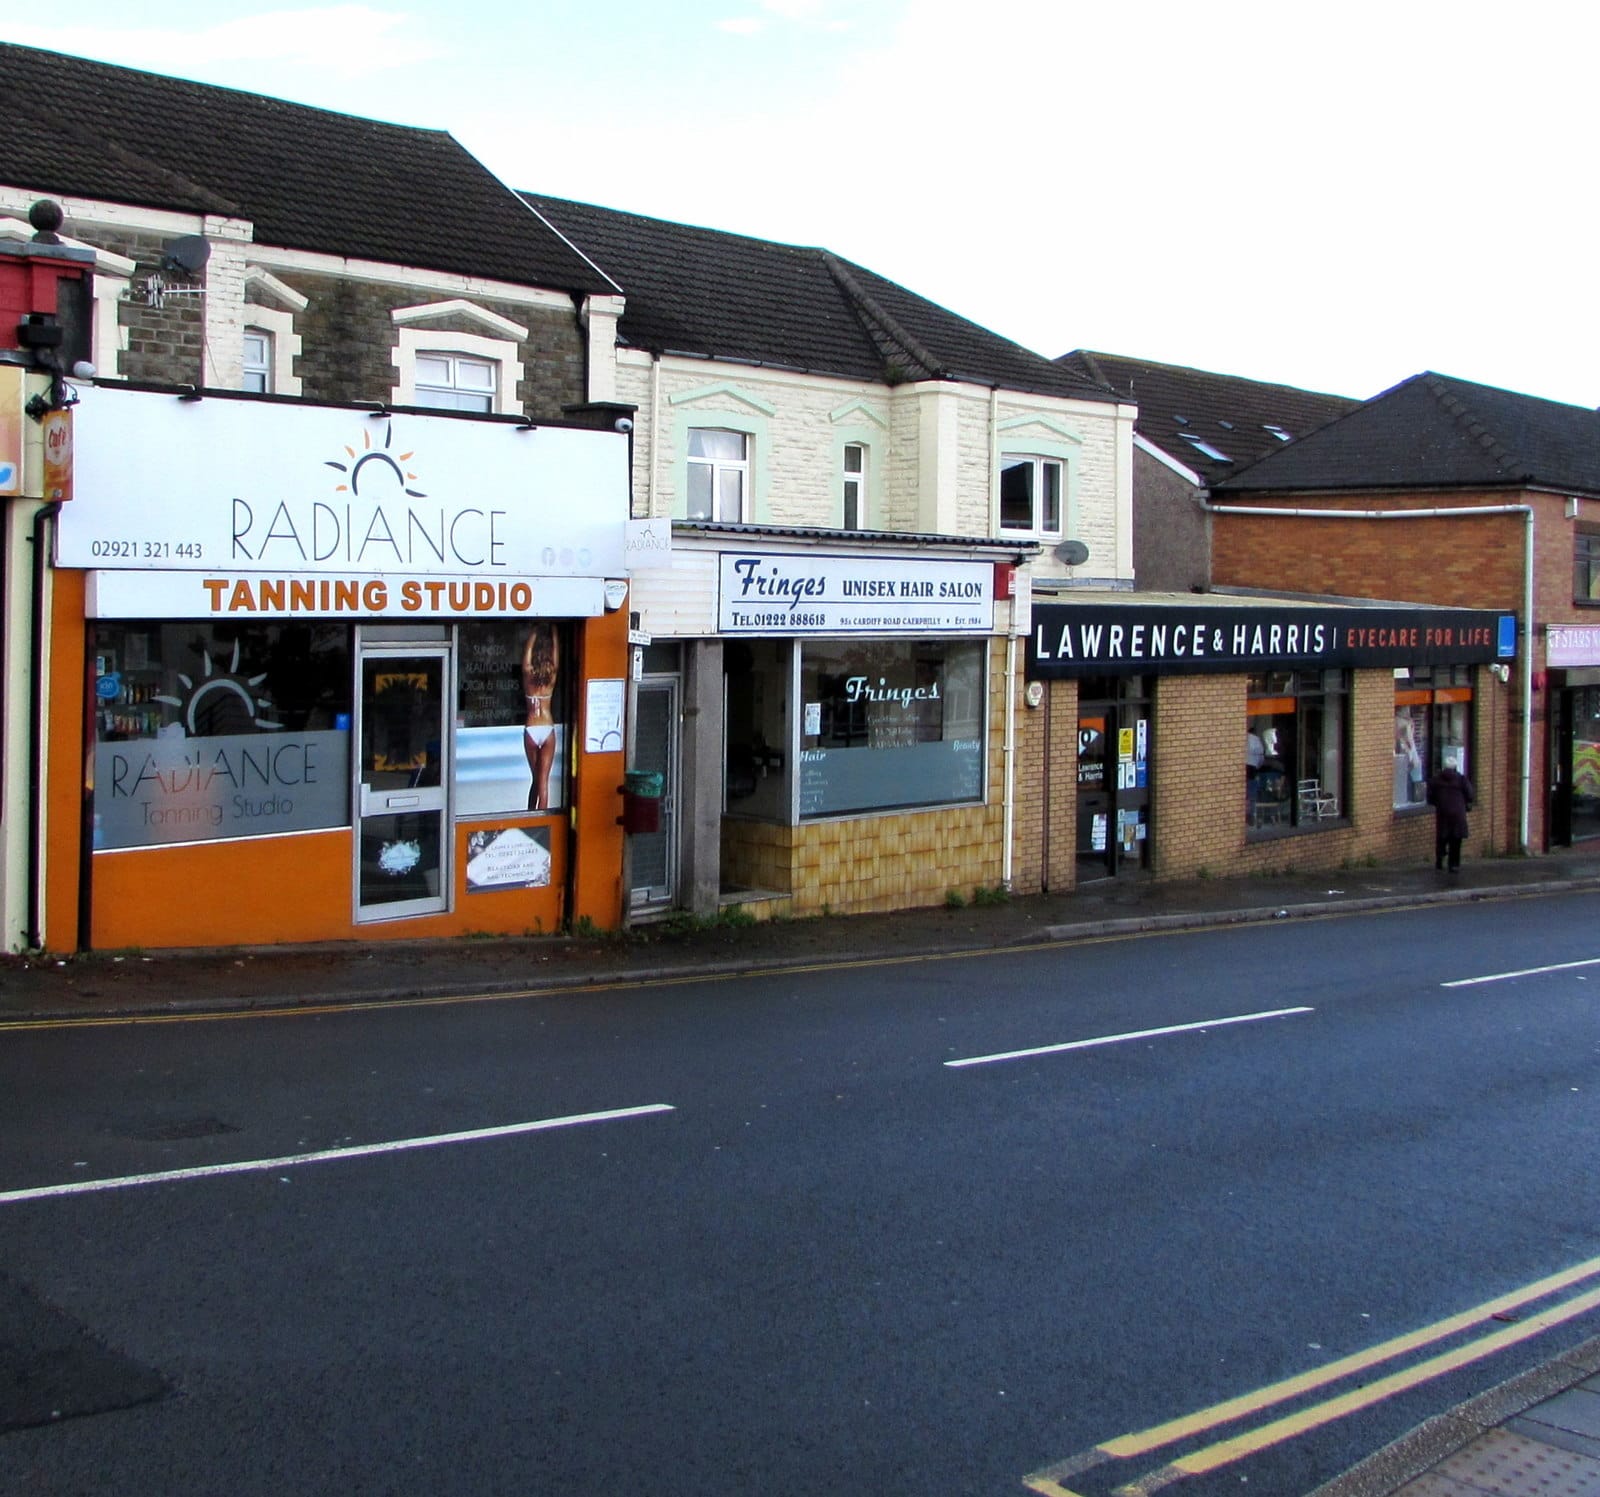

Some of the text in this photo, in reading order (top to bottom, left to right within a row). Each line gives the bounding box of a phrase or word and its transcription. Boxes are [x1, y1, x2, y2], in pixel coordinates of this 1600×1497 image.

[232, 498, 507, 566] RADIANCE
[91, 540, 202, 559] 02921 321 443
[203, 578, 533, 613] TANNING STUDIO
[734, 558, 826, 611] Fringes
[842, 580, 983, 598] UNISEX HAIR SALON
[789, 613, 826, 626] 888618
[853, 616, 882, 626] CARDIFF
[882, 616, 902, 626] ROAD
[1036, 623, 1325, 659] LAWRENCE & HARRIS
[1347, 627, 1491, 648] EYECARE FOR LIFE
[845, 676, 941, 709] Fringes
[112, 743, 318, 799] RADIANCE
[799, 750, 826, 762] Hair
[141, 794, 293, 827] Tanning Studio
